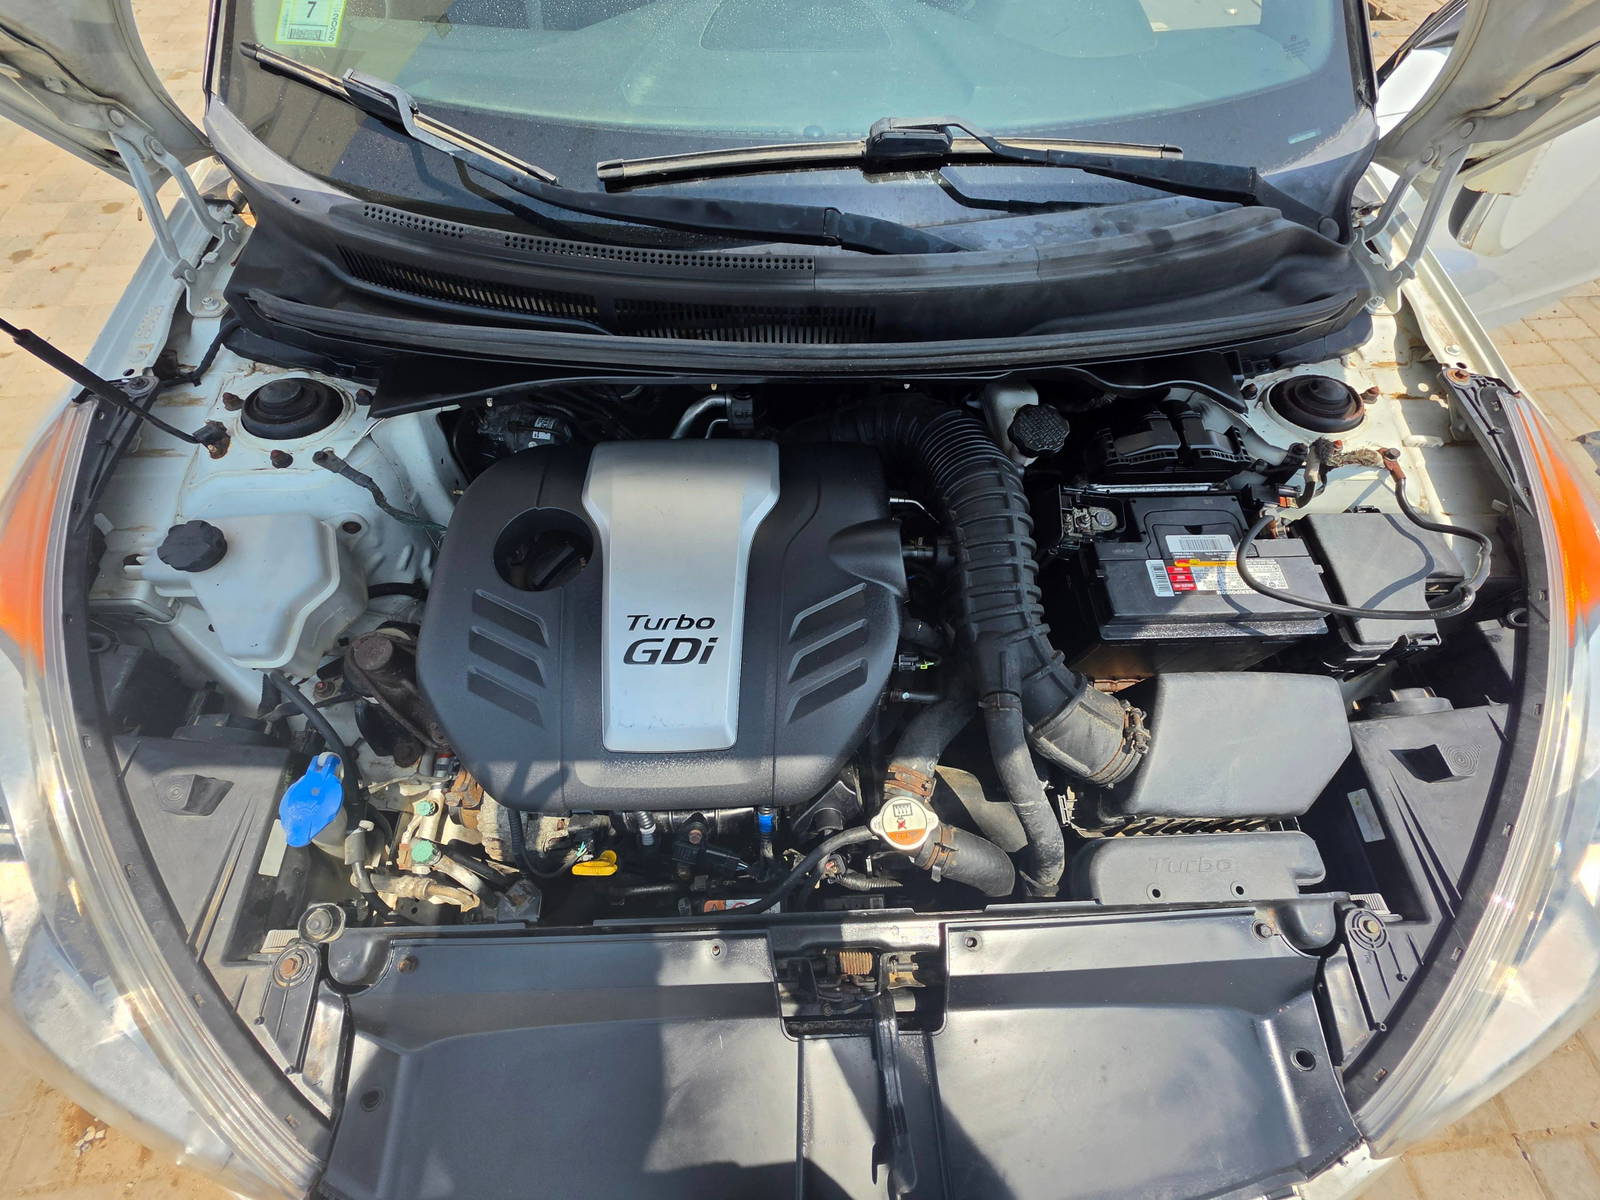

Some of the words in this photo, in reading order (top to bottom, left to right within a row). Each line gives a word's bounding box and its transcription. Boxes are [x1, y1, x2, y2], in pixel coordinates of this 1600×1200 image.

[307, 1, 317, 18] 7
[626, 614, 716, 631] Turbo
[623, 637, 719, 665] GDi
[1149, 856, 1233, 873] Turbo
